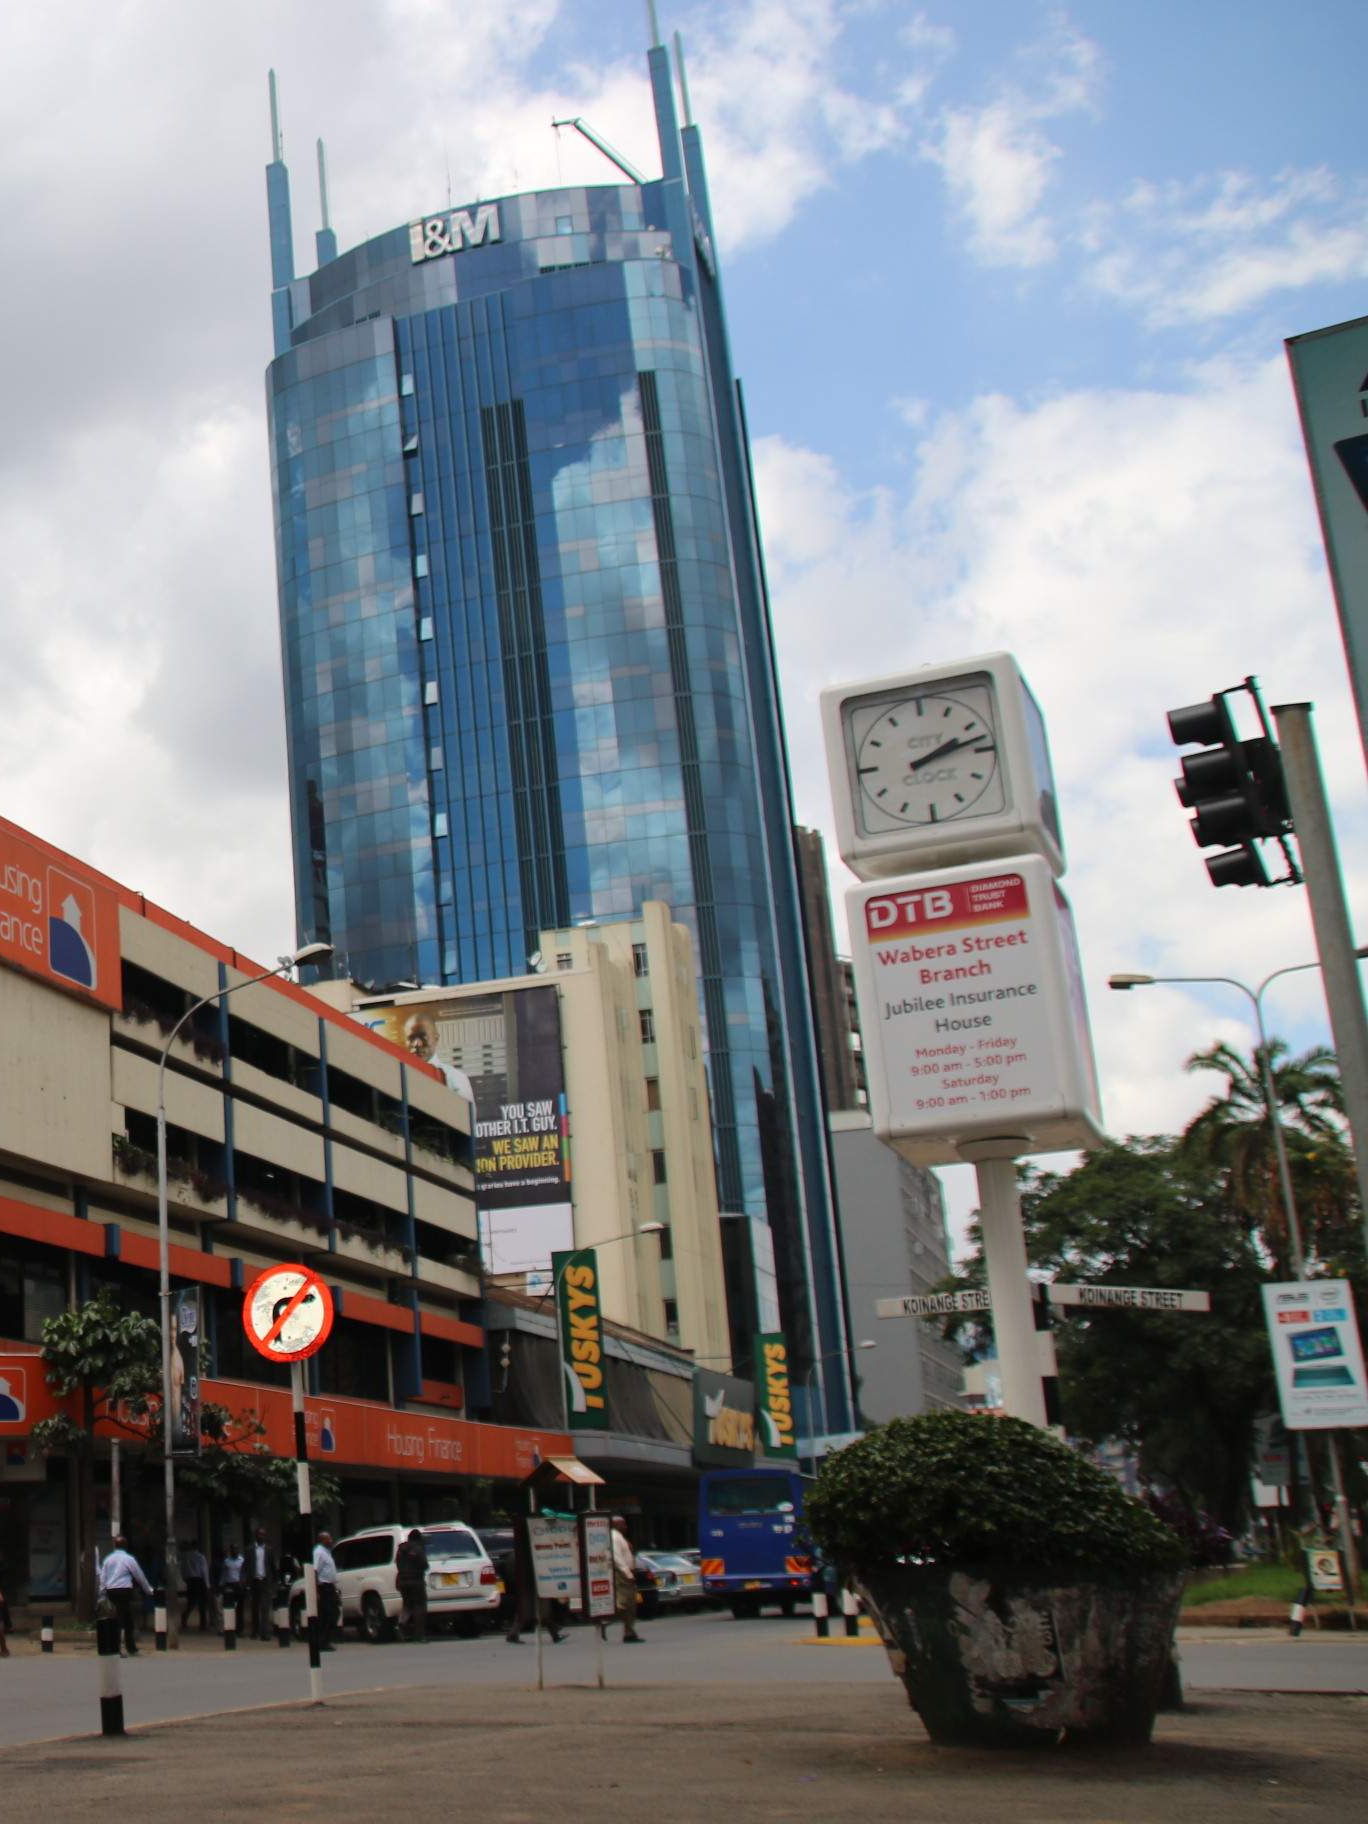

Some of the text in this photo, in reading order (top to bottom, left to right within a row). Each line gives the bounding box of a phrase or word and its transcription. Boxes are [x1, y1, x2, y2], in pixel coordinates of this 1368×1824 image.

[409, 204, 501, 263] I&M
[907, 732, 943, 749] CITY
[903, 768, 958, 786] CLOCK
[969, 878, 1021, 892] DIAMOND
[971, 890, 1006, 902] TRUST
[869, 890, 954, 929] DTB
[973, 901, 1005, 912] BANK
[878, 930, 1029, 966] Wabera Street
[920, 960, 992, 985] Branch
[884, 983, 1038, 1020] Jubilee Insurance
[935, 1014, 992, 1033] House
[915, 1044, 967, 1059] Monday
[977, 1037, 1017, 1050] Friday
[910, 1063, 940, 1076] 9:00
[942, 1062, 963, 1073] am
[973, 1055, 1002, 1068] 5:00
[1005, 1053, 1028, 1066] pm
[942, 1073, 999, 1089] Saturday
[916, 1097, 945, 1110] 9:00
[948, 1095, 969, 1105] am
[979, 1088, 1007, 1102] 1:00
[1009, 1087, 1031, 1100] pm
[500, 1101, 553, 1120] YOU SAW
[532, 1115, 558, 1132] GUY.
[493, 1134, 559, 1154] WE SAW AN
[499, 1152, 560, 1171] PROVIDER.
[903, 1291, 993, 1315] KOINANGE STRE
[1079, 1287, 1184, 1309] KOINANGE STREET
[563, 1264, 605, 1411] TUSKYS
[763, 1342, 795, 1448] TUSKYS
